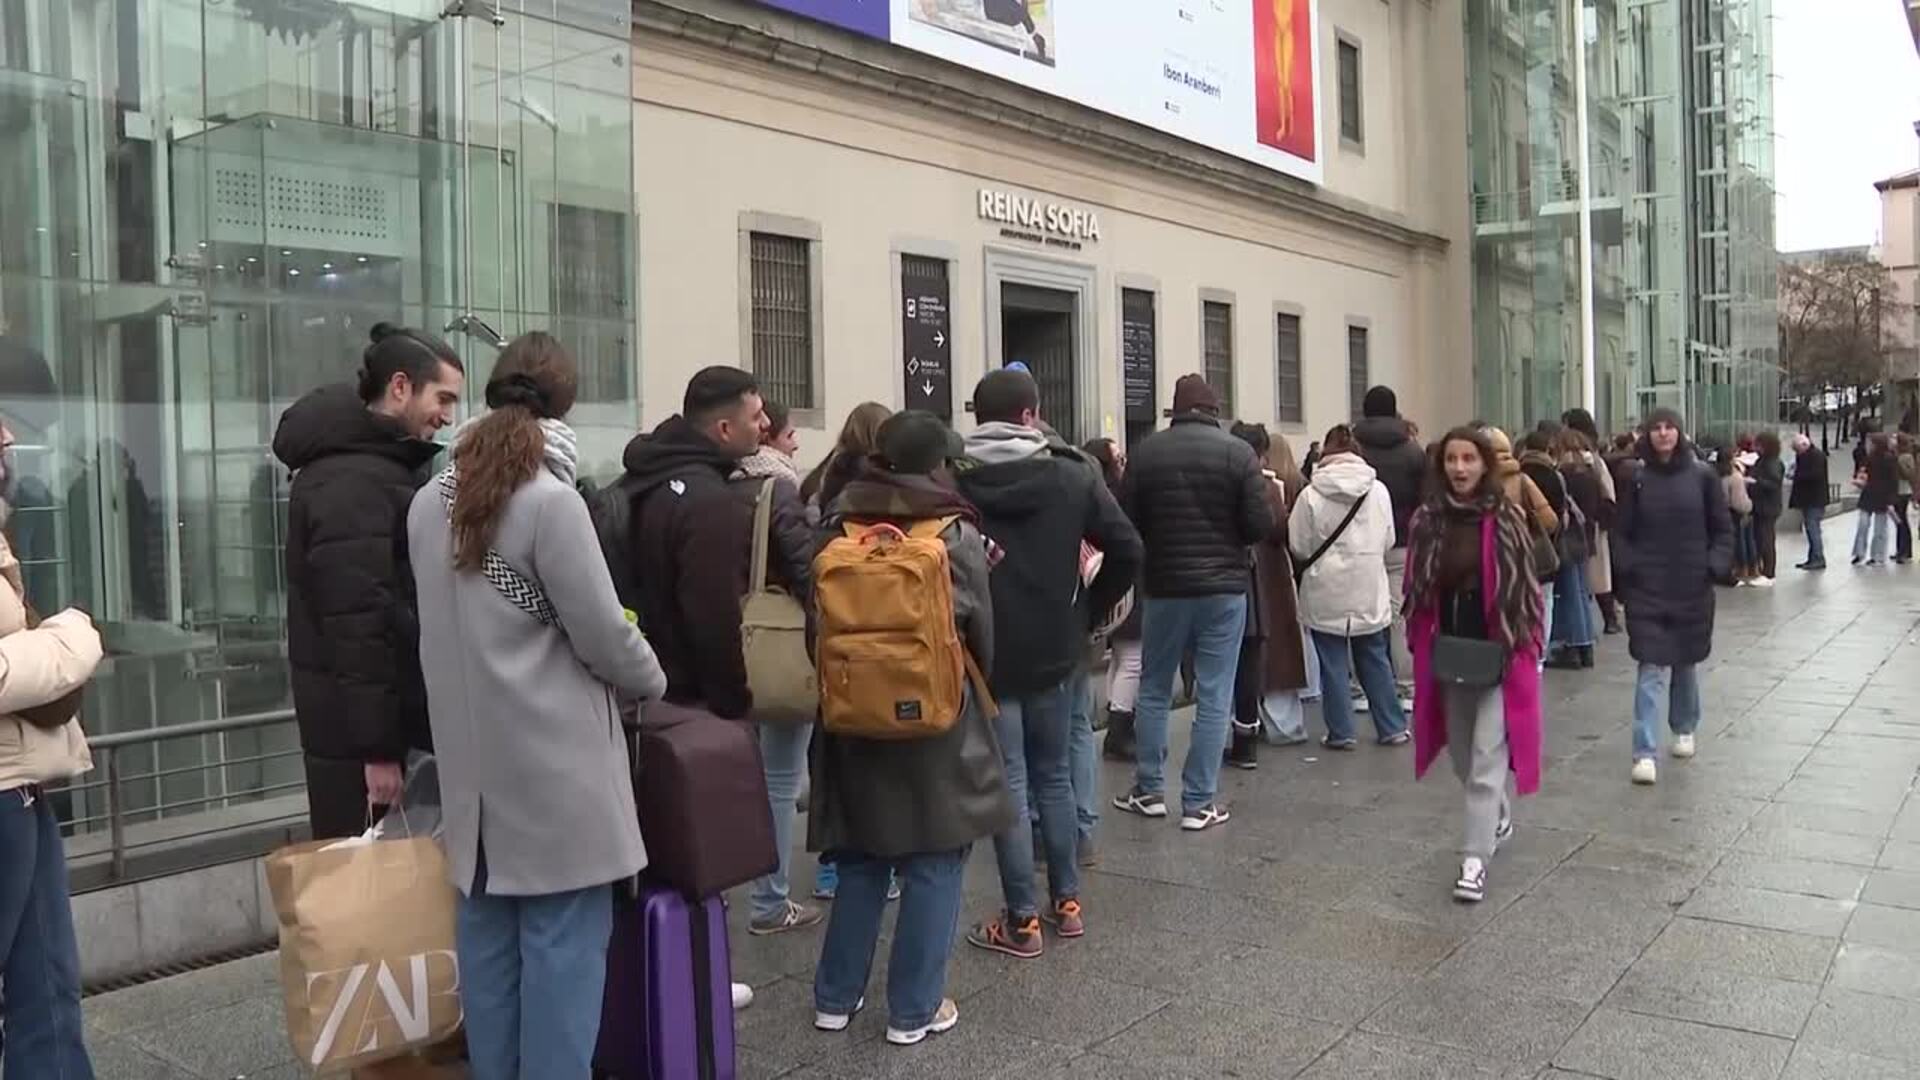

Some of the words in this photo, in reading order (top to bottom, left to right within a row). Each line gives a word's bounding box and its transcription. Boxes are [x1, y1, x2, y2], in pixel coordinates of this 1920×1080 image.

[1163, 63, 1182, 83] Ibon
[978, 189, 1043, 228] REINA
[1046, 203, 1100, 241] SOFIA
